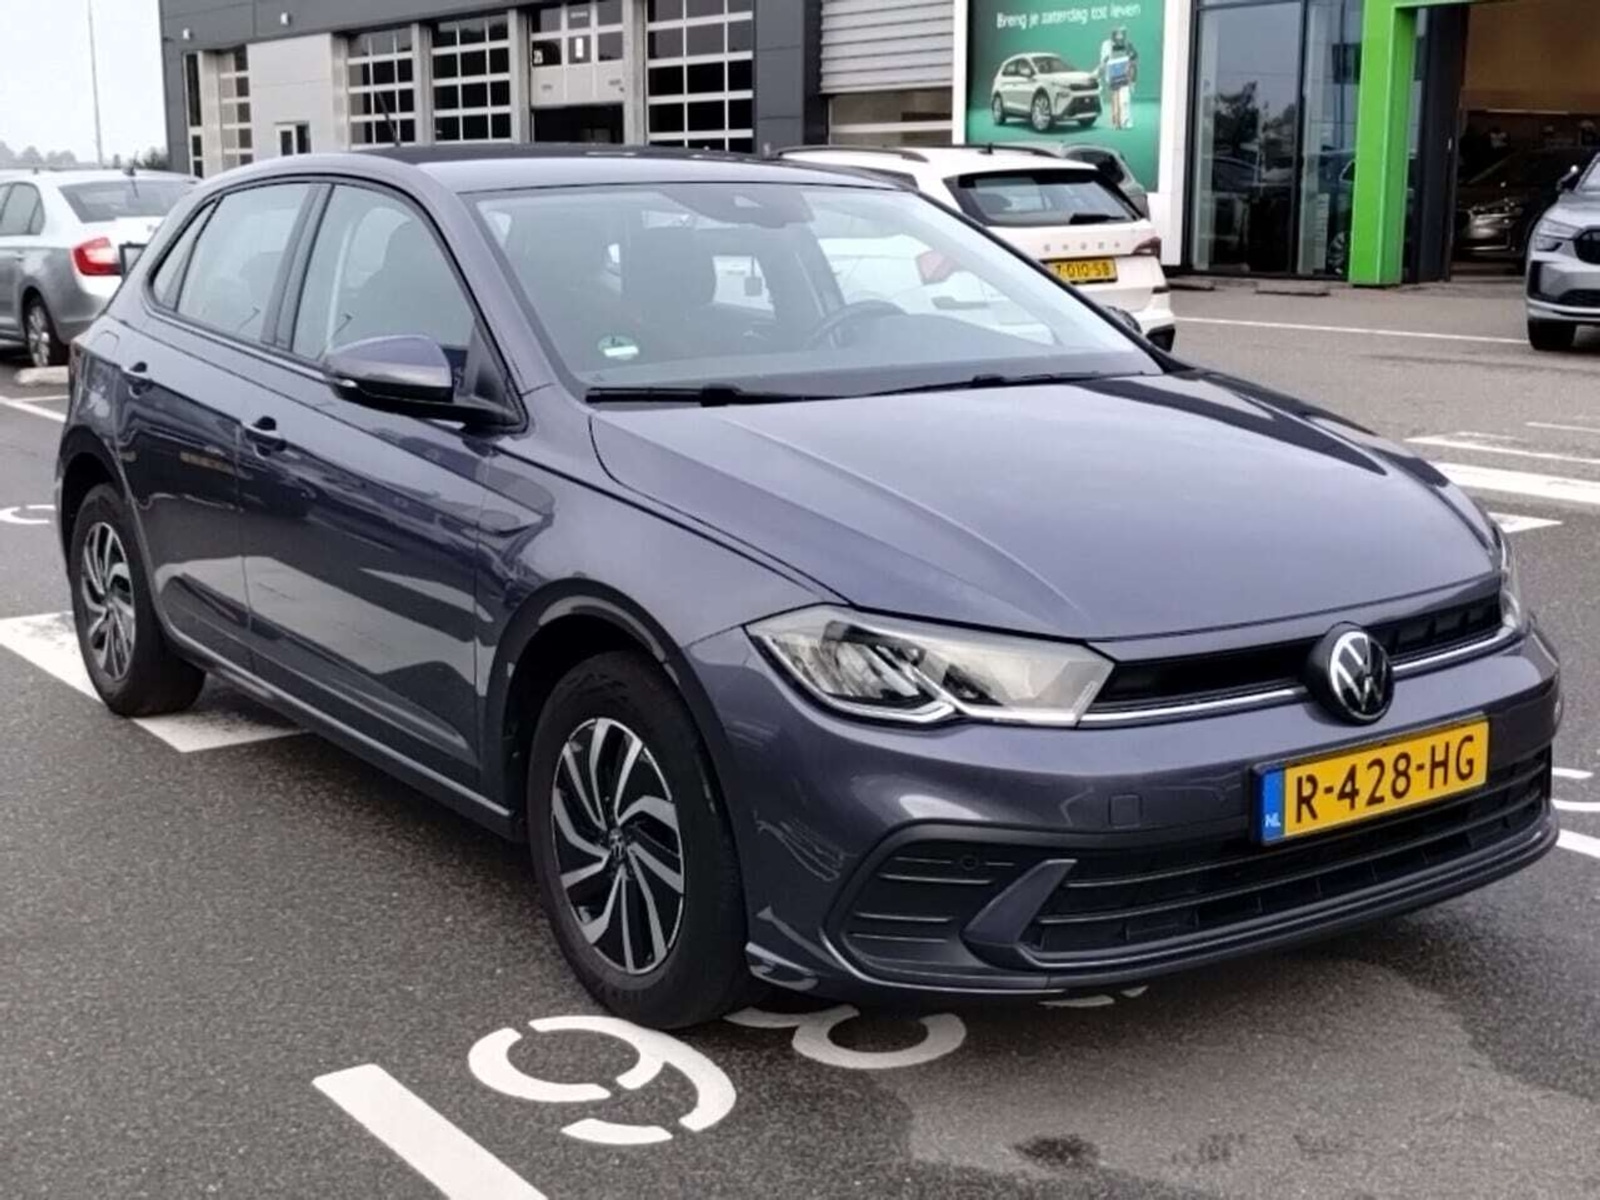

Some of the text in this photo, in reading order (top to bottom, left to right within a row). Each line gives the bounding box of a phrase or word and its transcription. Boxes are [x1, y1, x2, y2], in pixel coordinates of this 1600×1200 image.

[996, 12, 1027, 30] Breng
[1028, 13, 1039, 28] je
[1090, 5, 1107, 20] tot
[1110, 3, 1141, 18] leven
[1264, 734, 1475, 828] NL R-428-HG
